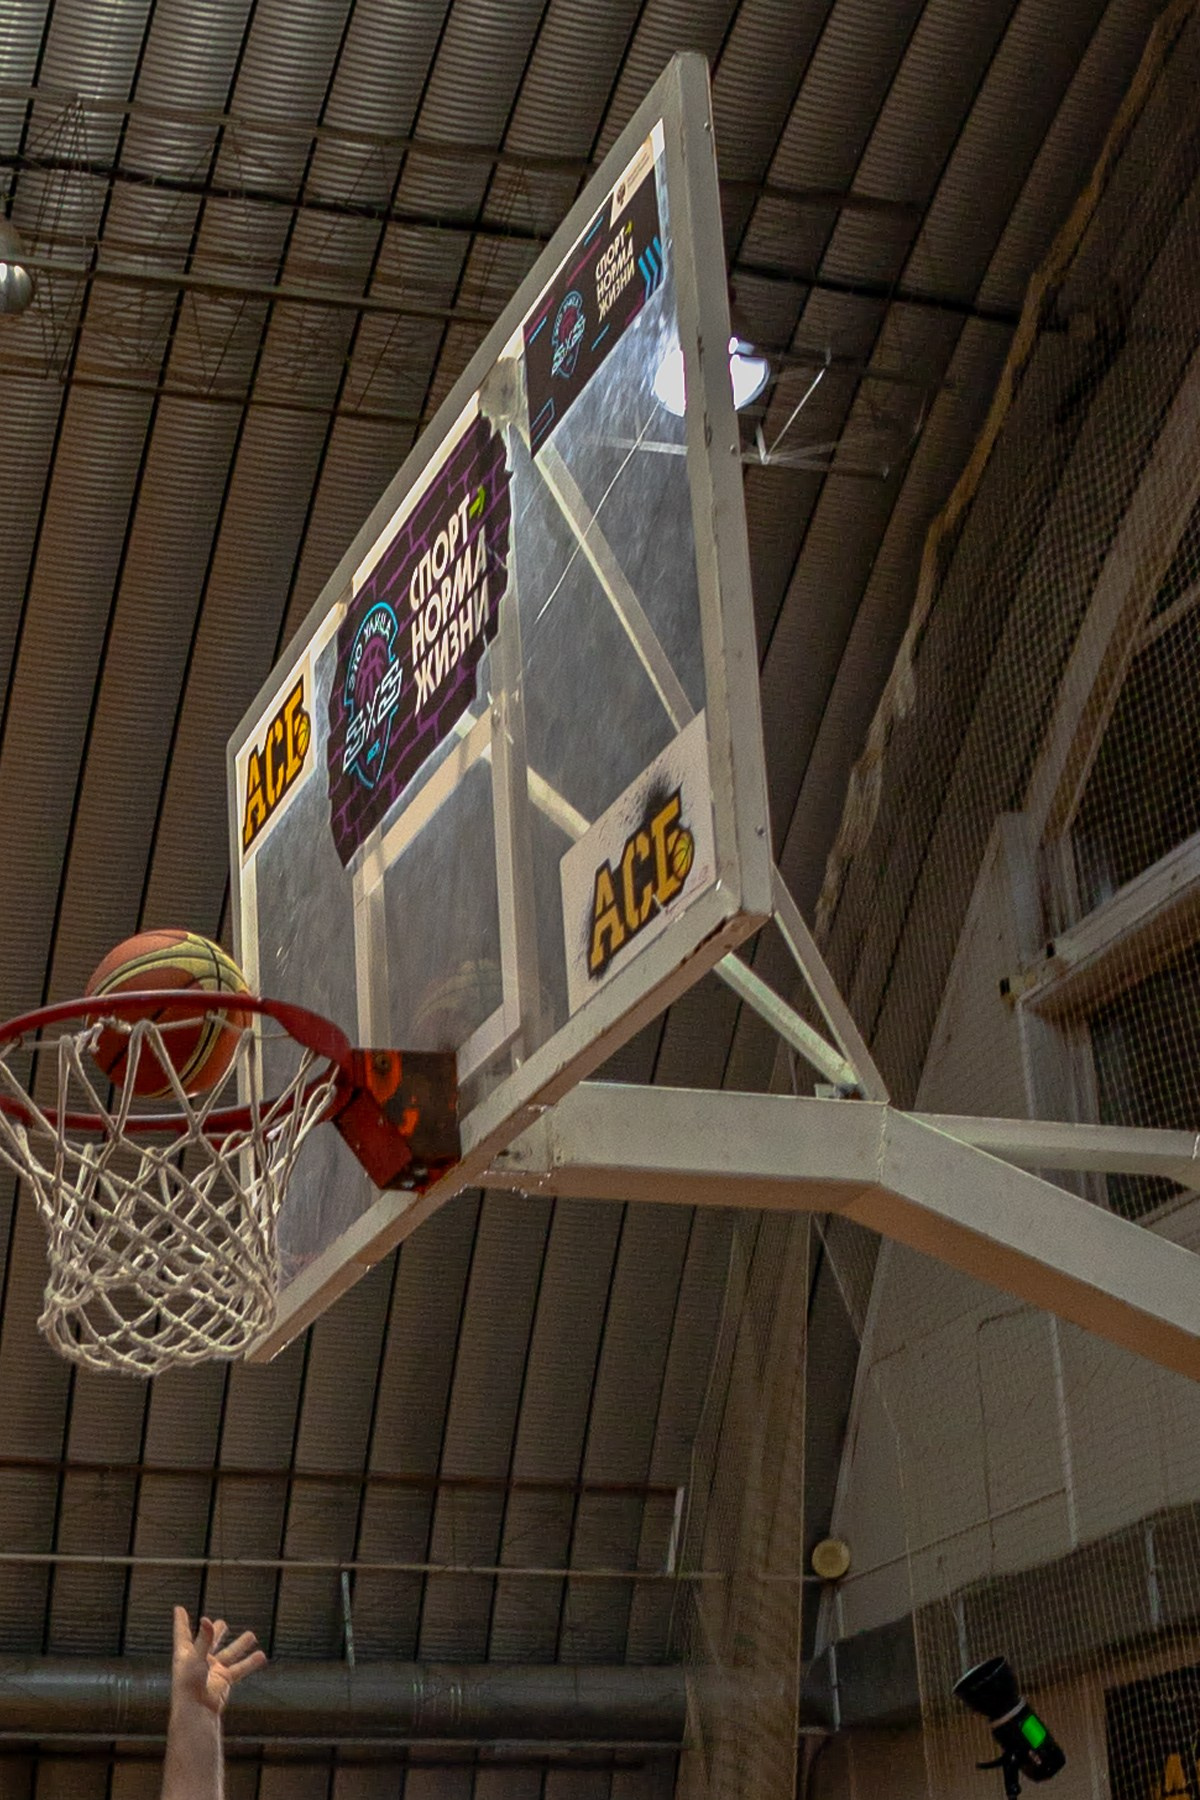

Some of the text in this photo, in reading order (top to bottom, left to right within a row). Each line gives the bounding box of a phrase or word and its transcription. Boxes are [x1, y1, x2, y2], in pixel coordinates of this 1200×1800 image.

[595, 226, 626, 280] СПОРТ
[597, 237, 634, 301] НОРМА
[598, 257, 635, 323] ЖИЗНИ
[410, 493, 470, 611] СПОРТ
[411, 525, 487, 666] НОРМА
[414, 576, 490, 716] ЖИЗНИ
